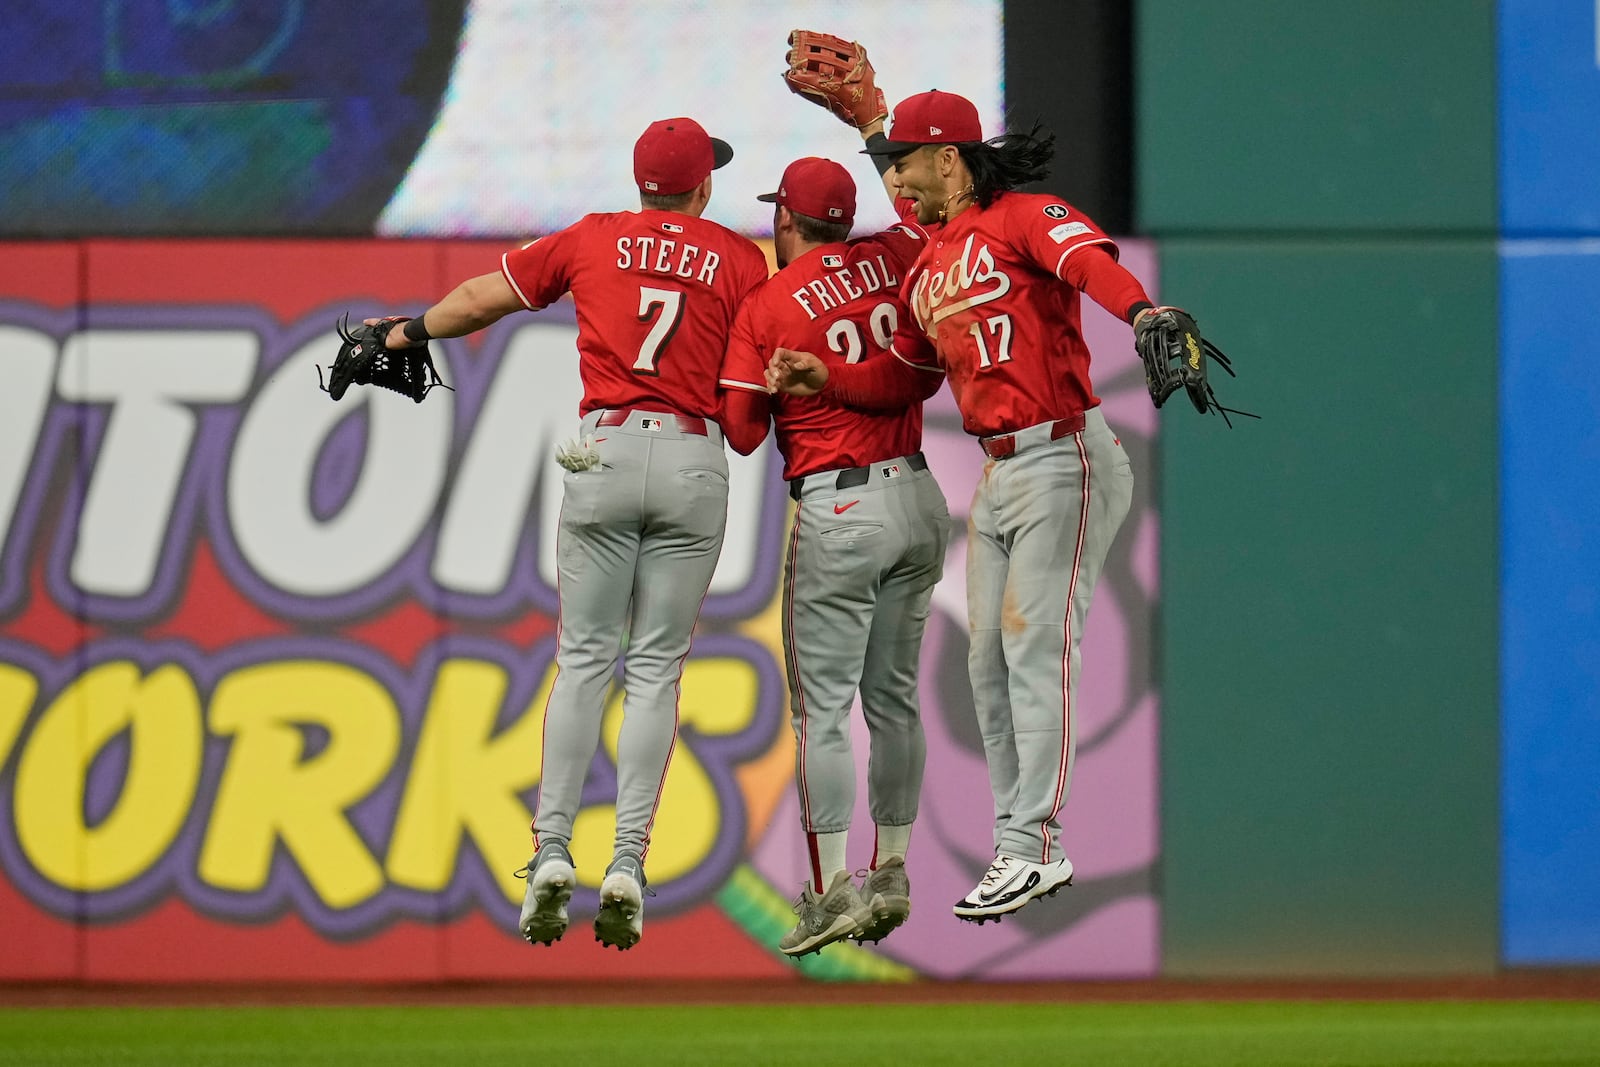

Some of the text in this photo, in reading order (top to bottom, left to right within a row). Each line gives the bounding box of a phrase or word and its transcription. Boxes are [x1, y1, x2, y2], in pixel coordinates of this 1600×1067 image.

[1046, 206, 1065, 217] 14
[617, 237, 721, 287] STEER
[792, 255, 898, 320] FRIEDL
[909, 233, 1010, 339] Reds
[632, 286, 685, 376] 7
[969, 314, 1013, 369] 17
[0, 325, 771, 597] TOM
[0, 657, 758, 908] ORKS
